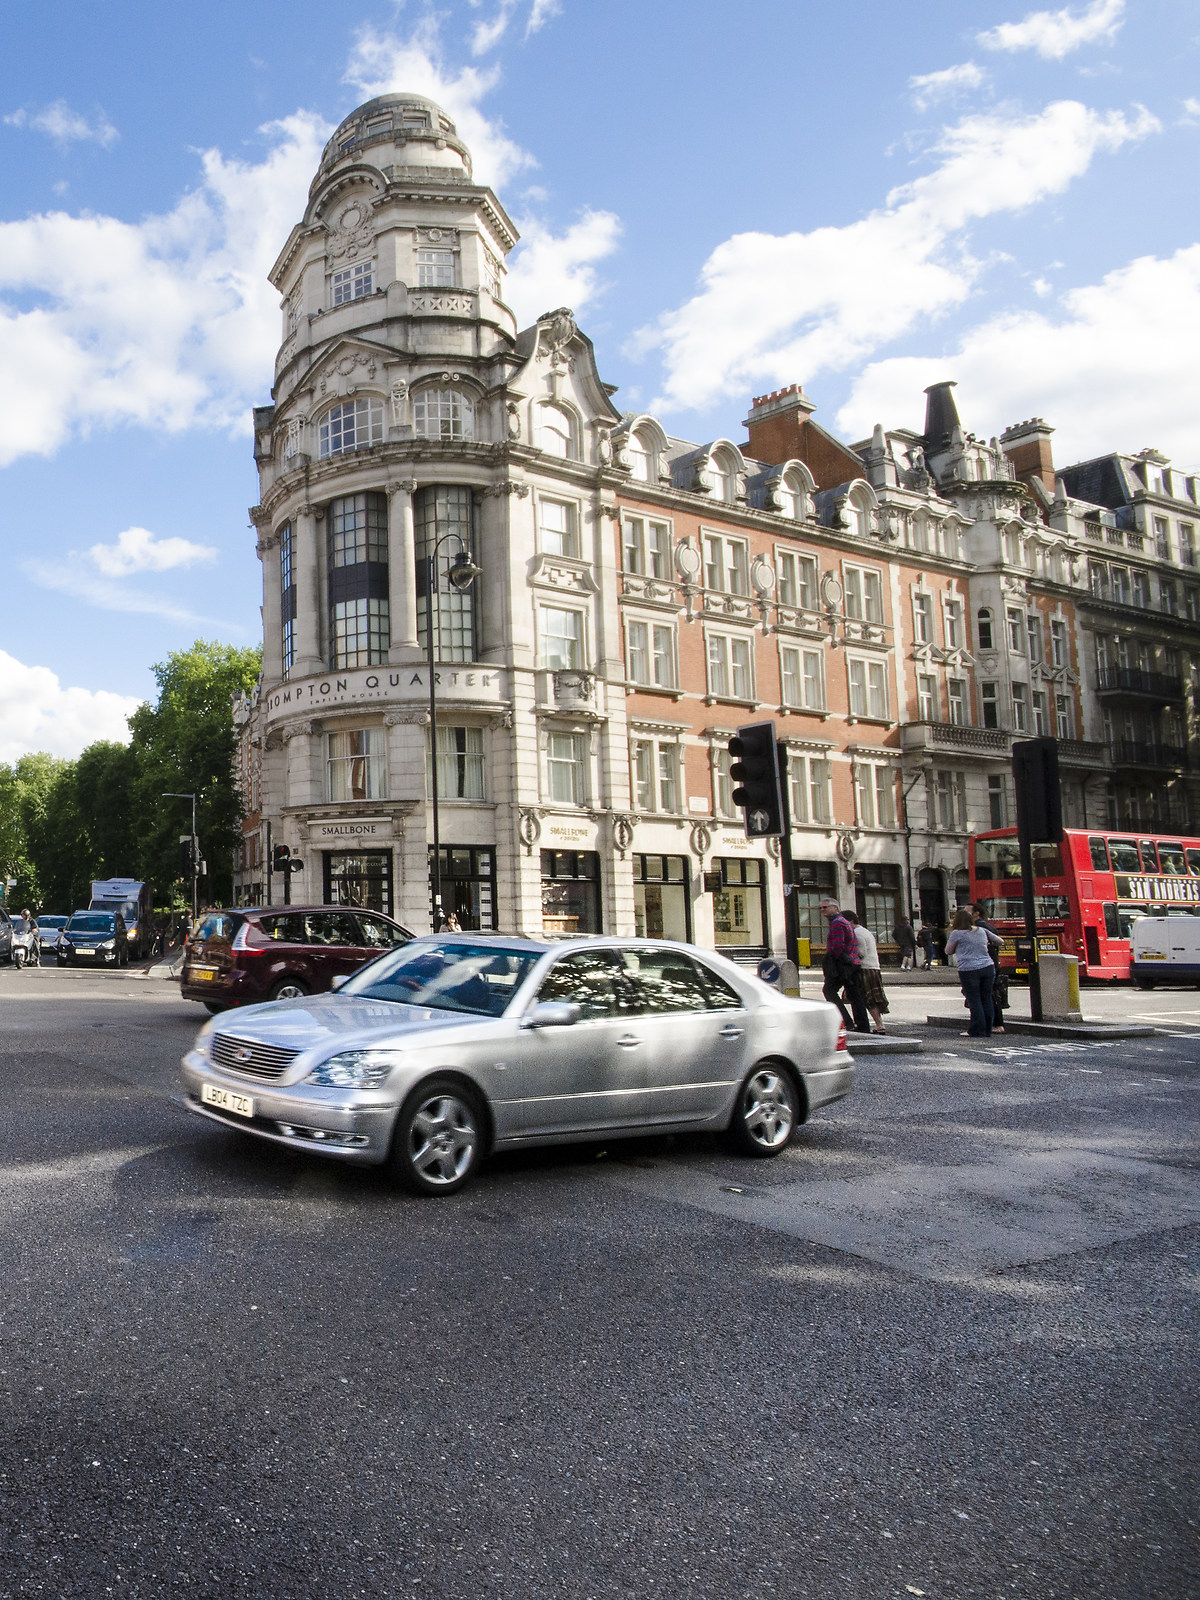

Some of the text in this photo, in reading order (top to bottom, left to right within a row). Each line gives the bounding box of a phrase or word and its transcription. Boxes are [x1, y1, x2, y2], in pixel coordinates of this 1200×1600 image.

[267, 672, 491, 712] OMPTON QUARTER
[310, 695, 344, 705] EMPIRE
[322, 825, 376, 835] SMALLBONE
[1129, 881, 1199, 900] SAN ANDREAS
[206, 1087, 249, 1112] LB04 TZC
